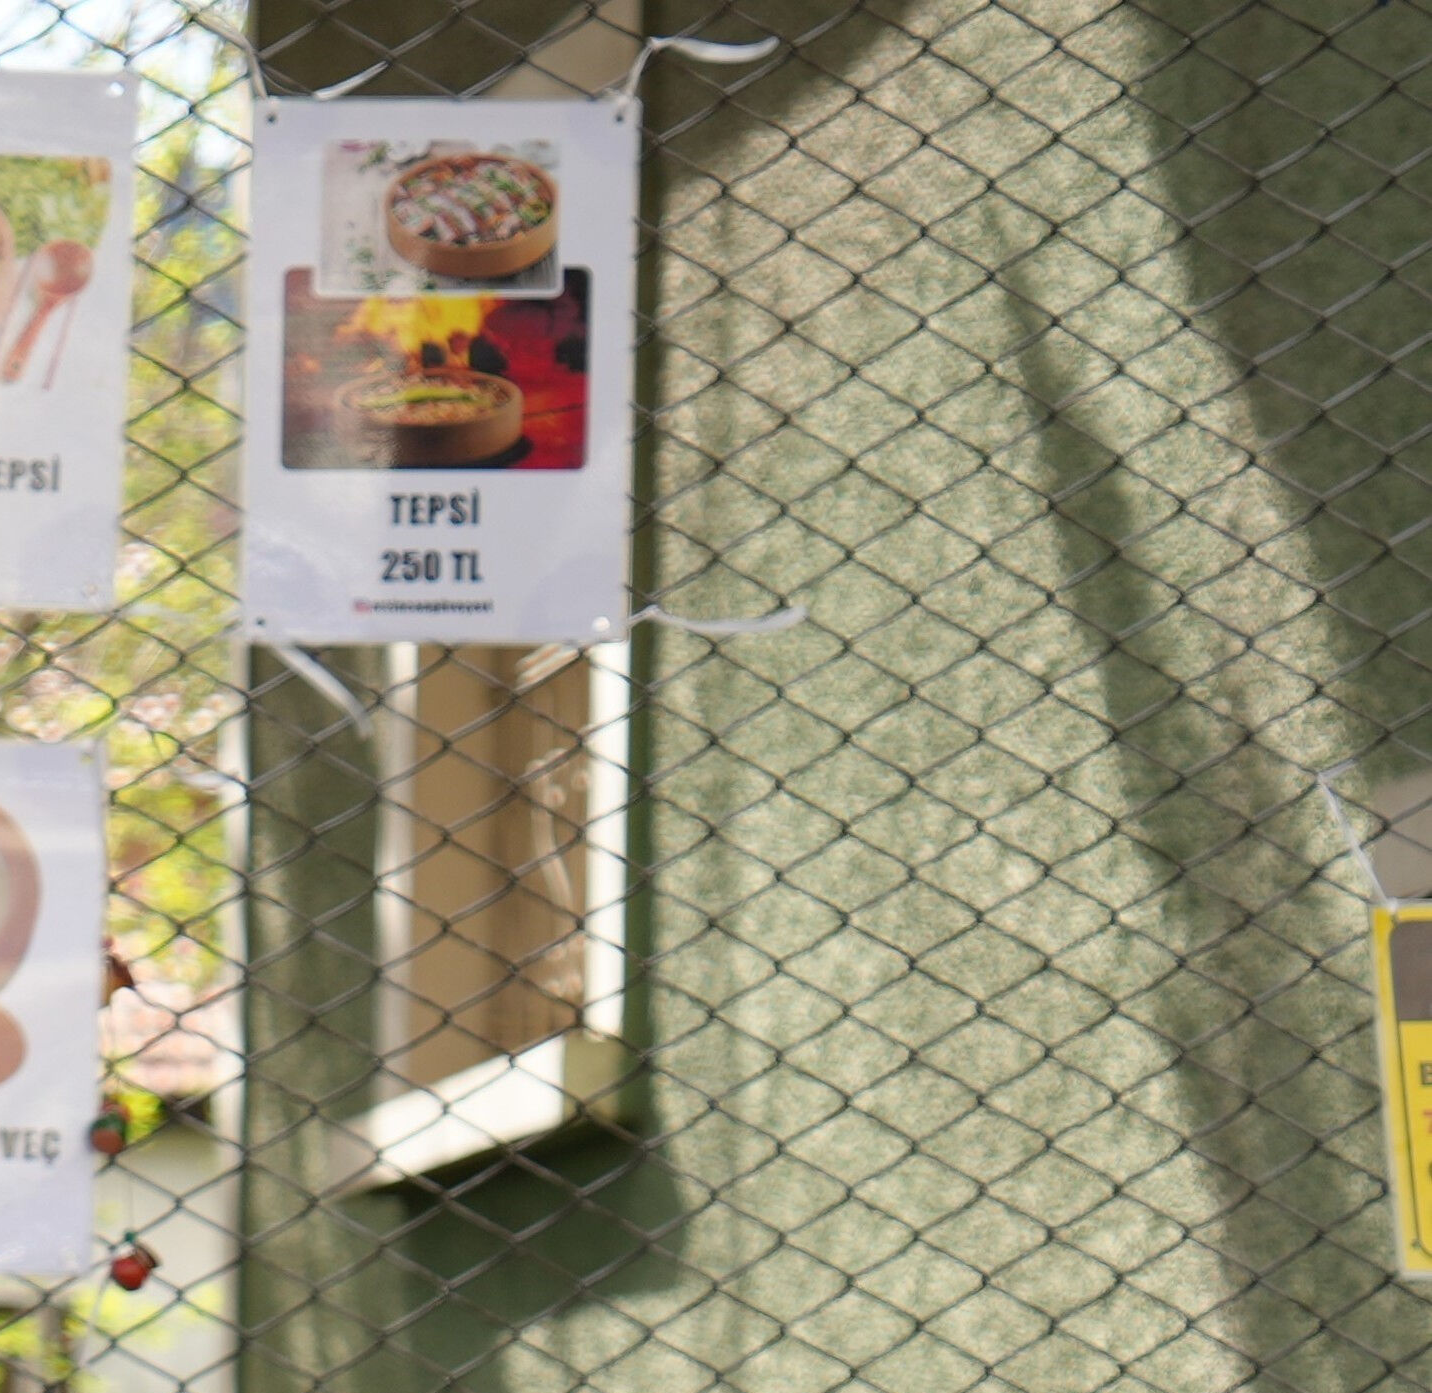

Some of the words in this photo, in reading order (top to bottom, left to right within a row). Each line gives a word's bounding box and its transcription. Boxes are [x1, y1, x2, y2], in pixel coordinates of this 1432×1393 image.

[391, 487, 481, 525] TEPSİ
[381, 550, 442, 582] 250
[452, 551, 483, 582] TL
